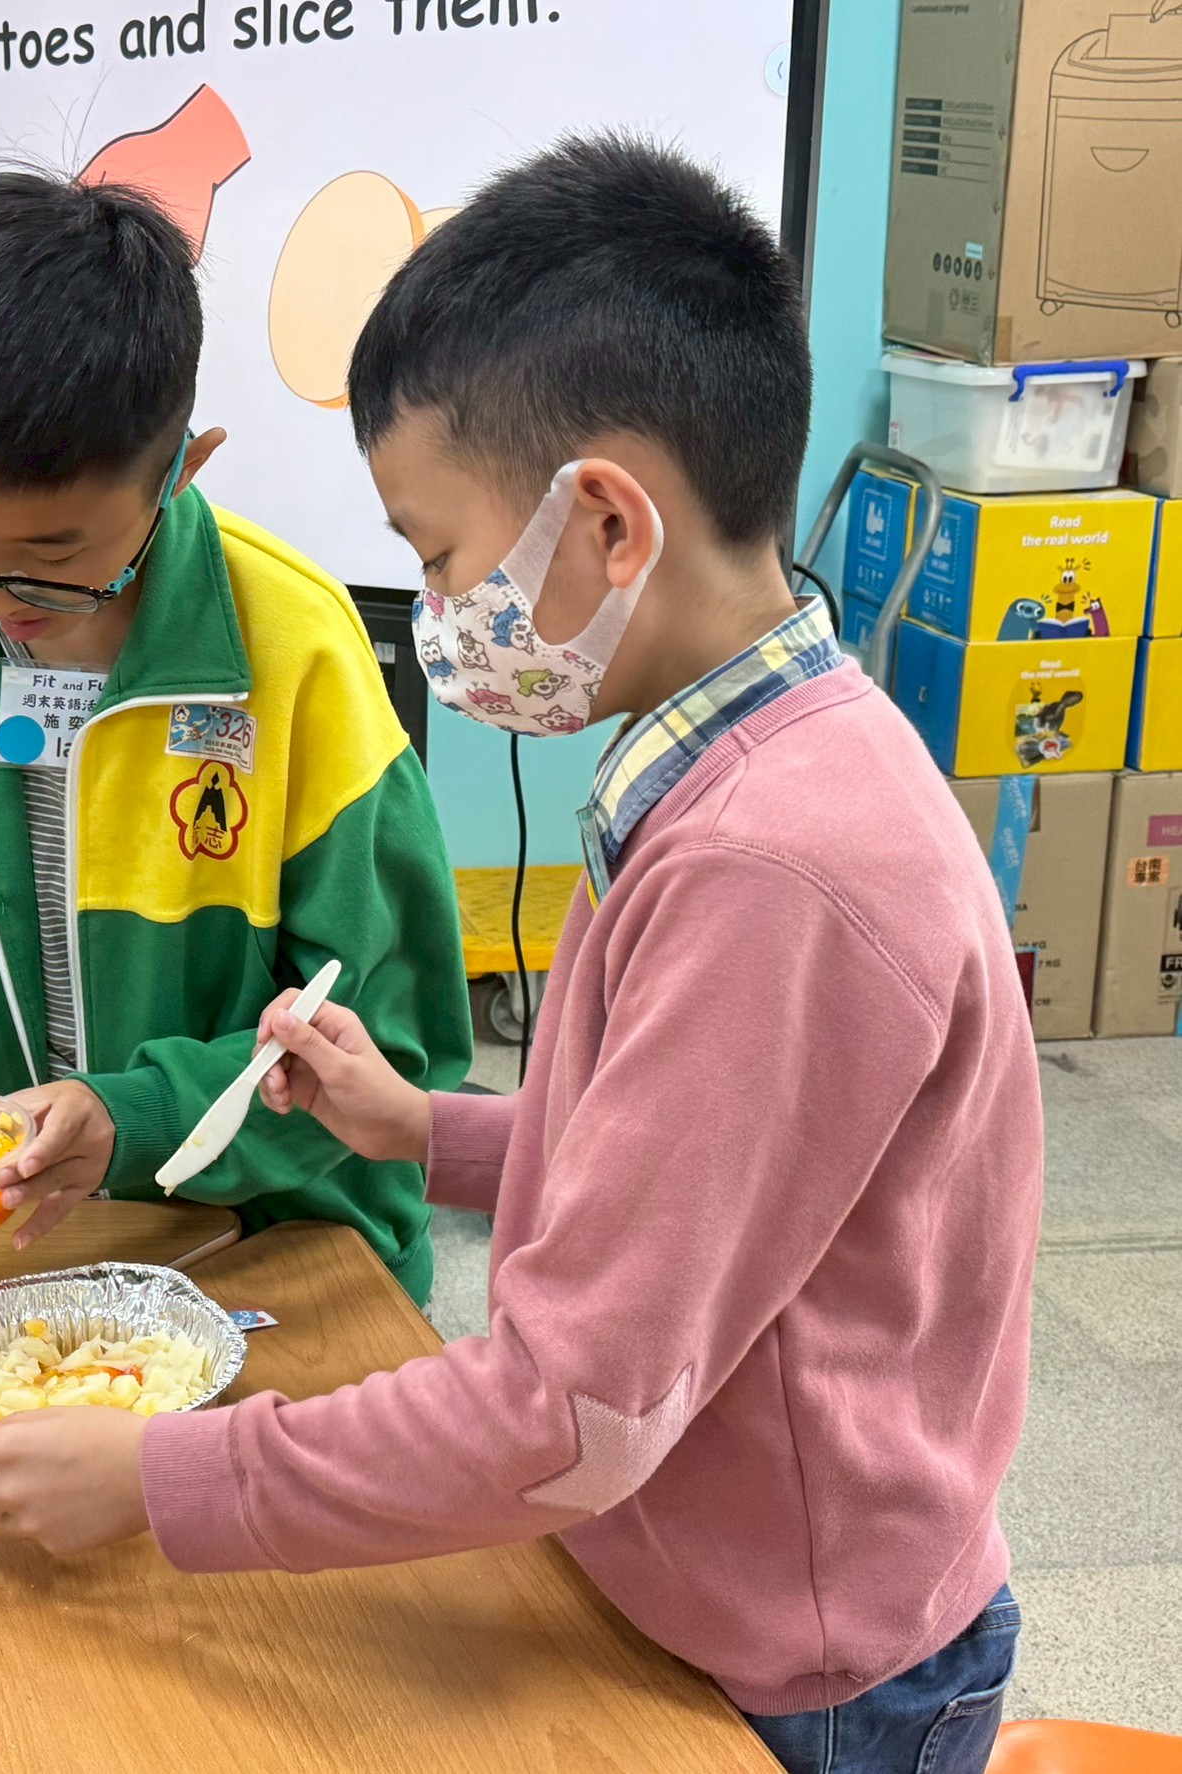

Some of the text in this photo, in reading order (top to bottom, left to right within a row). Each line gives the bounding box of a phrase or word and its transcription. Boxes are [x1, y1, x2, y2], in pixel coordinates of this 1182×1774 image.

[119, 0, 206, 60] and
[232, 0, 354, 50] slice
[1049, 515, 1082, 529] Read
[1021, 531, 1110, 547] the real world
[32, 674, 57, 689] Fit
[62, 681, 84, 691] and
[215, 711, 252, 750] 326
